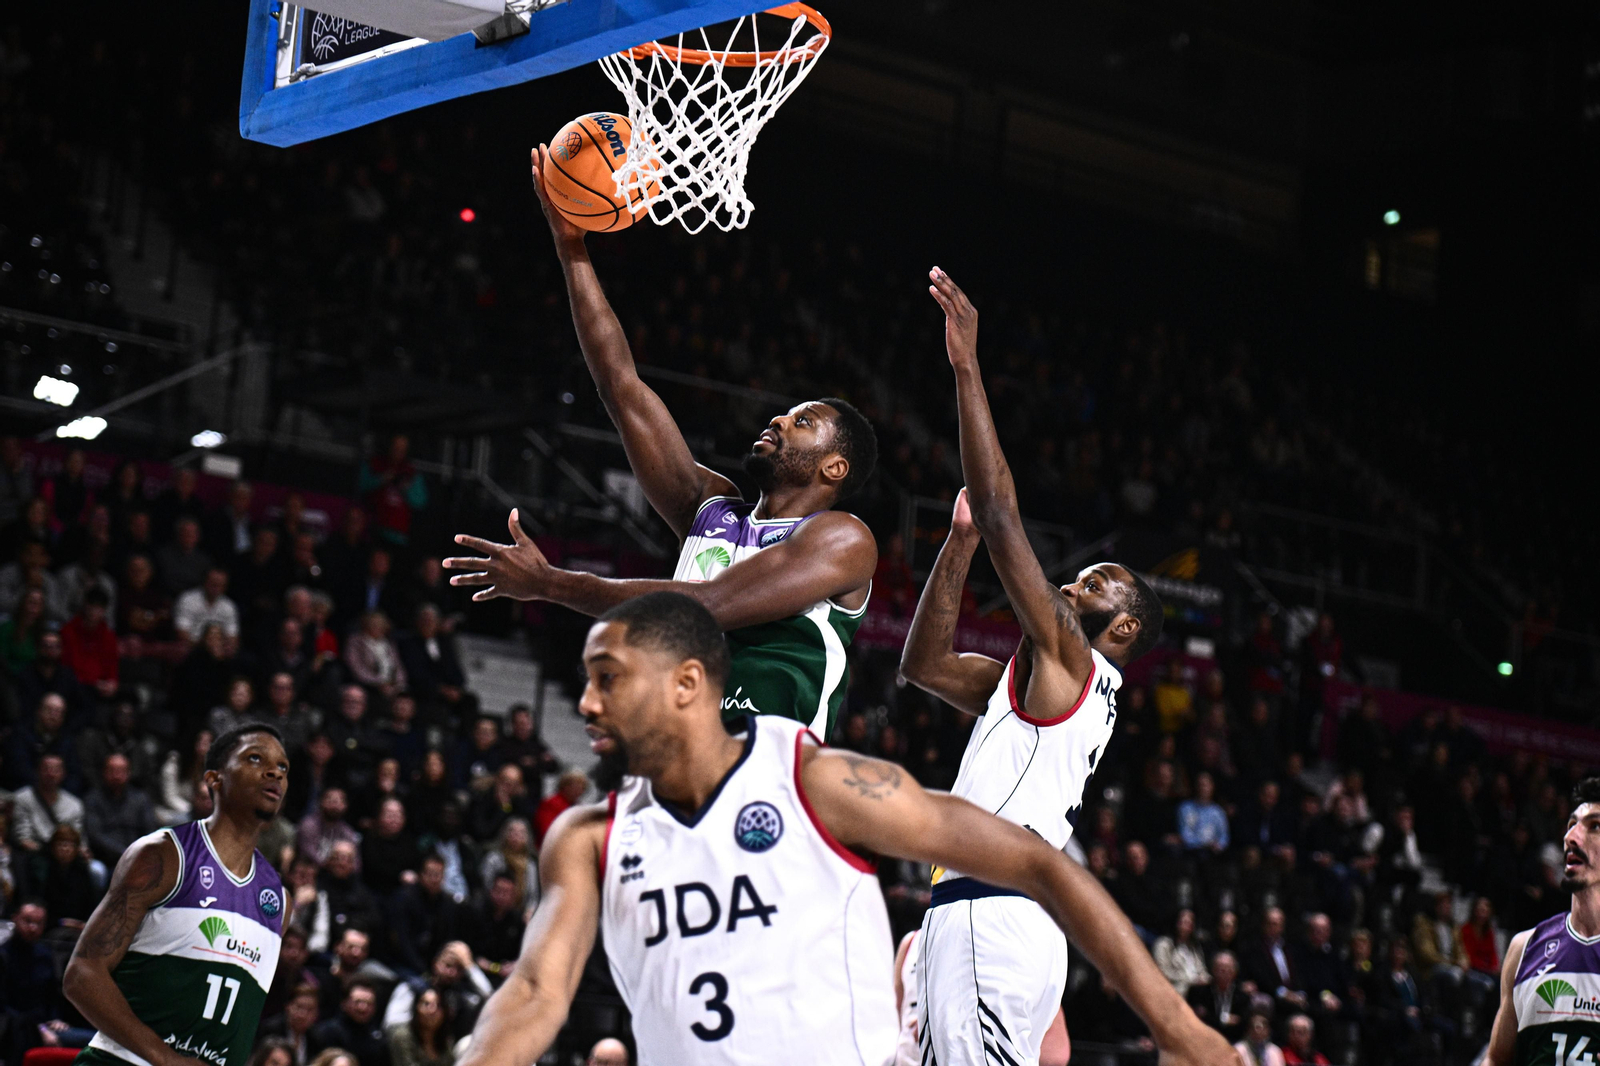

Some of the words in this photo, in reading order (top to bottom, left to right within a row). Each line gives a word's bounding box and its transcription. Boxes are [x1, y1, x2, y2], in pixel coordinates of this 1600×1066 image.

[345, 26, 380, 45] LEAGUE
[639, 874, 779, 947] JDA
[202, 973, 241, 1025] 11
[688, 971, 735, 1042] 3
[1552, 1033, 1596, 1066] 14
